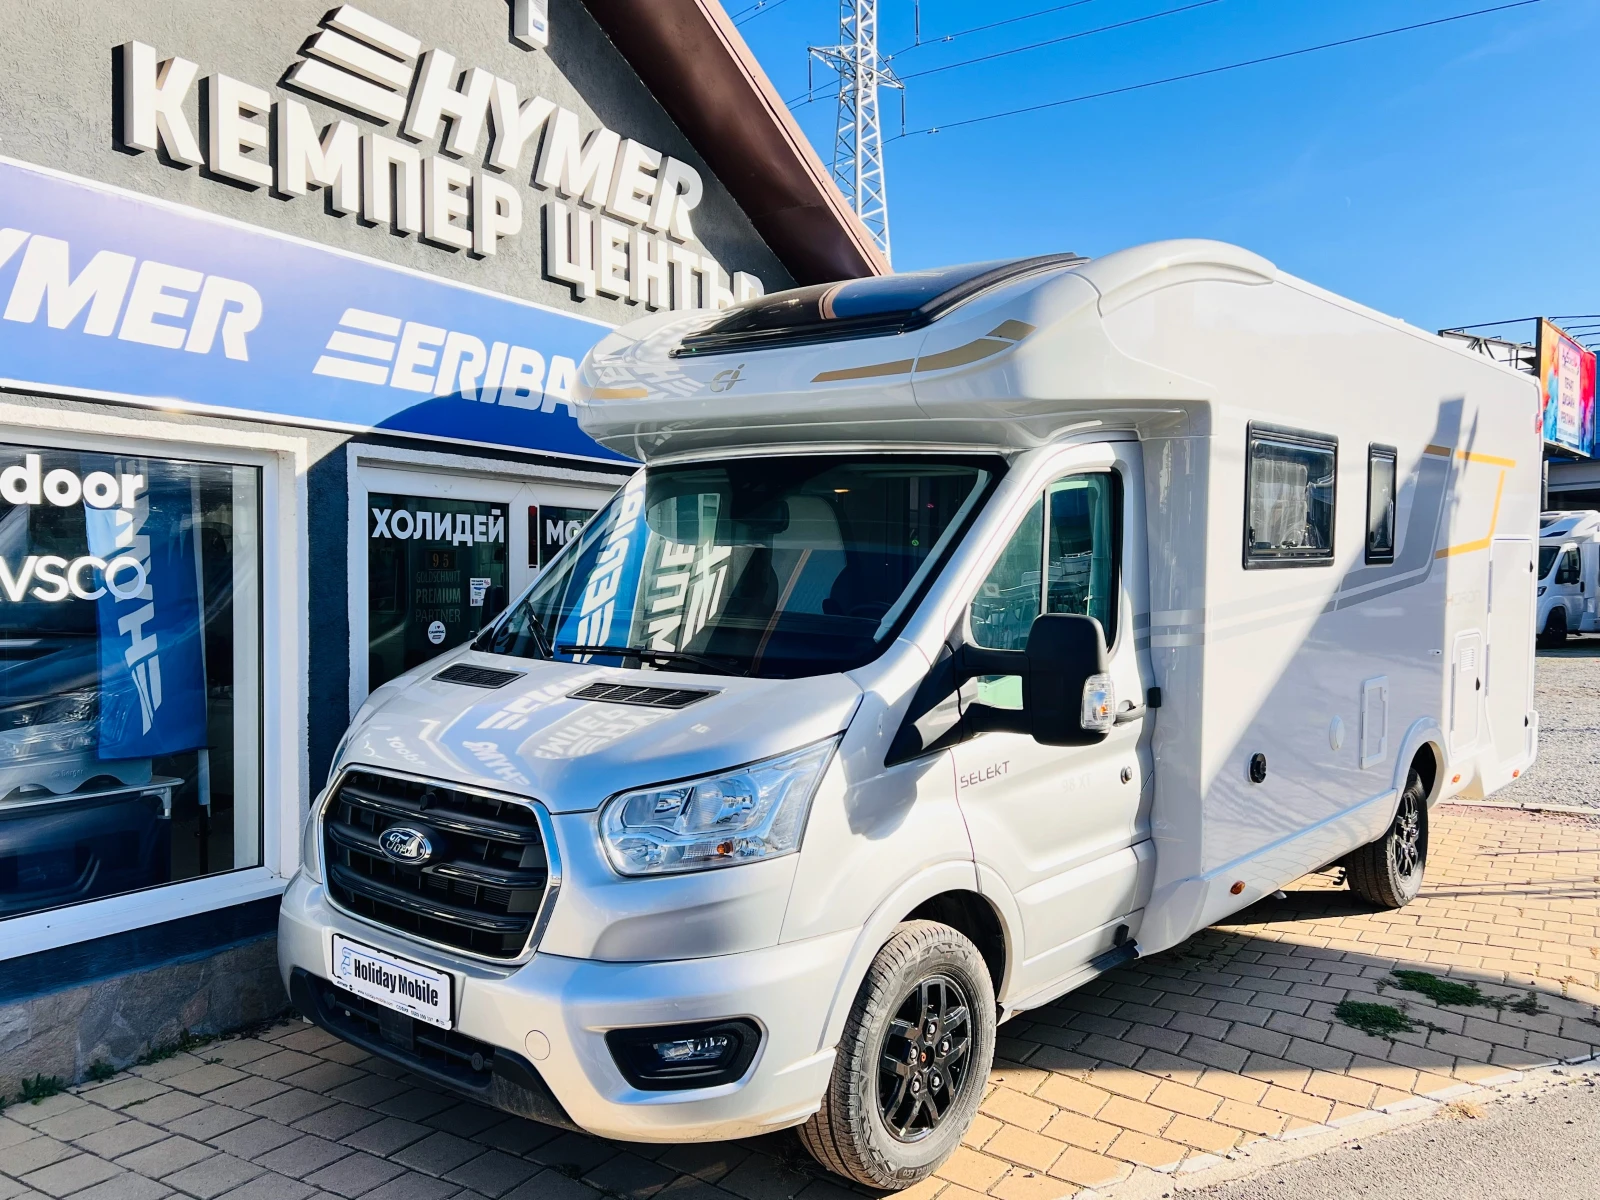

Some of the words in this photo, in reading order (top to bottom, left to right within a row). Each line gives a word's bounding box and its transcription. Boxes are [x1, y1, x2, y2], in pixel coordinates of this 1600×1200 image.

[120, 39, 523, 258] КЕМПЕР
[404, 48, 704, 244] HYMER
[371, 507, 505, 547] ХОЛИДЕЙ
[546, 518, 591, 546] МО
[415, 588, 461, 604] PREMIUM
[415, 608, 461, 623] PARTNER
[960, 760, 1010, 789] SELEKT
[354, 958, 397, 993] Holiday
[398, 974, 438, 1006] Mobile
